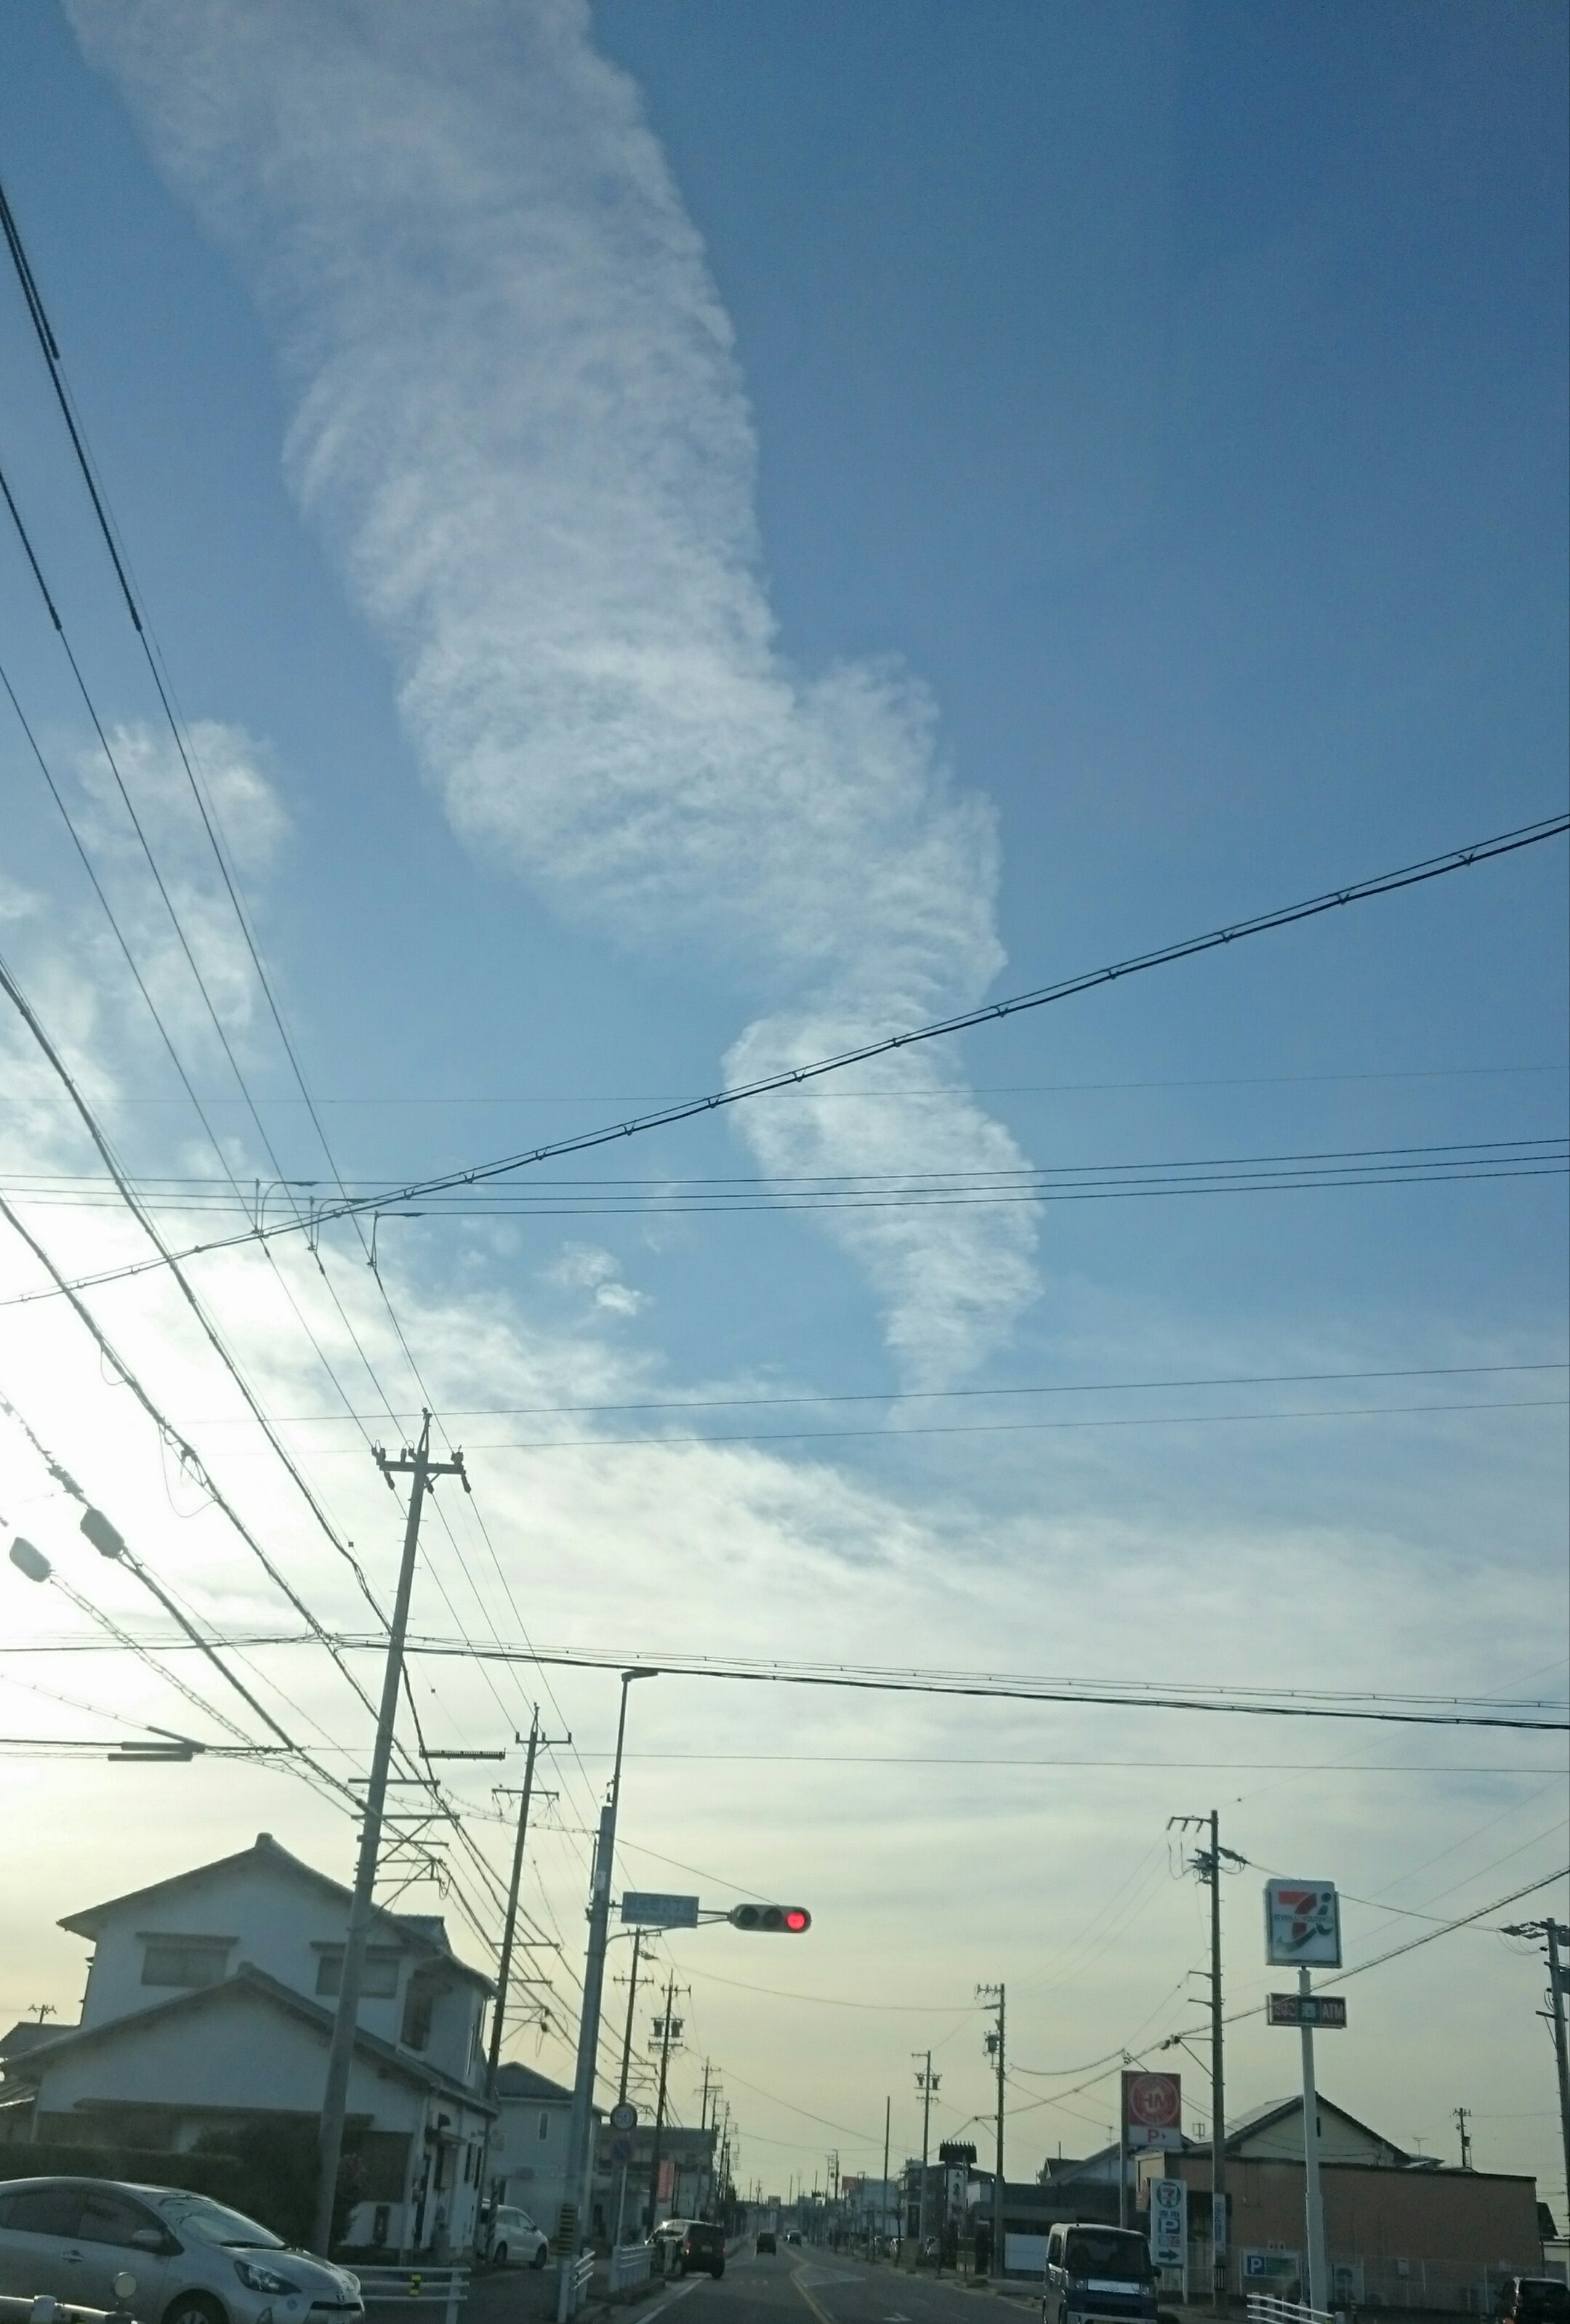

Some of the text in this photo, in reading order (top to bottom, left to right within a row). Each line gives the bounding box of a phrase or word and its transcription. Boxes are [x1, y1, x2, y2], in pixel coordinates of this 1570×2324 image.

[1323, 2004, 1343, 2019] ATM
[616, 2110, 632, 2124] 50
[1148, 2129, 1159, 2143] P
[1161, 2219, 1178, 2234] P
[1250, 2257, 1262, 2274] P
